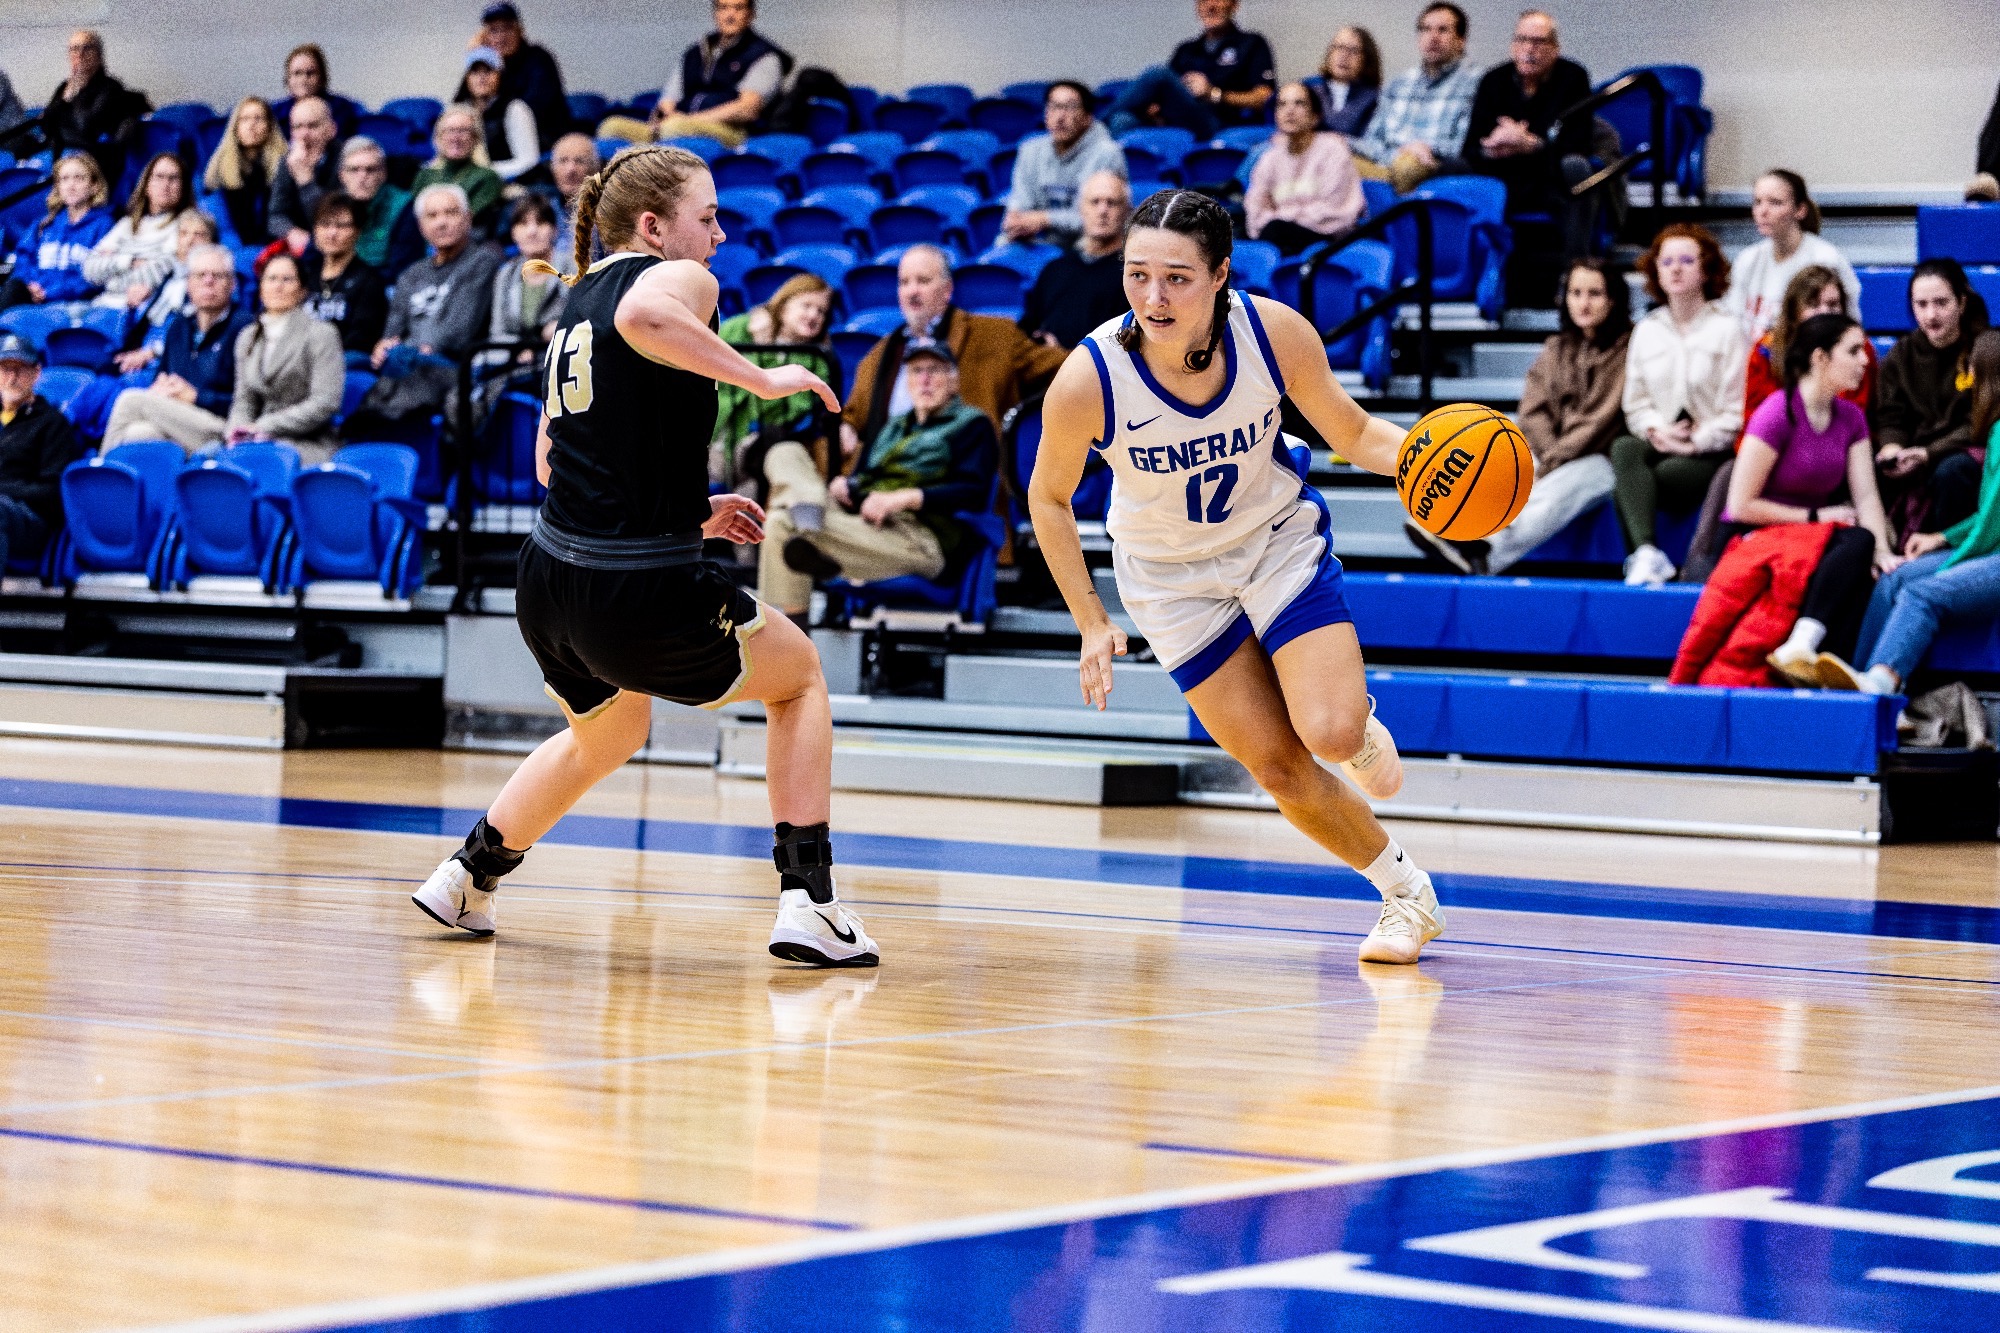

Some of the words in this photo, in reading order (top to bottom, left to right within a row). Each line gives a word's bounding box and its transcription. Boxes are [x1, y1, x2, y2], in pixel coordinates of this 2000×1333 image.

[544, 319, 594, 420] 13
[1185, 463, 1239, 524] 12
[1415, 447, 1476, 521] Wilson
